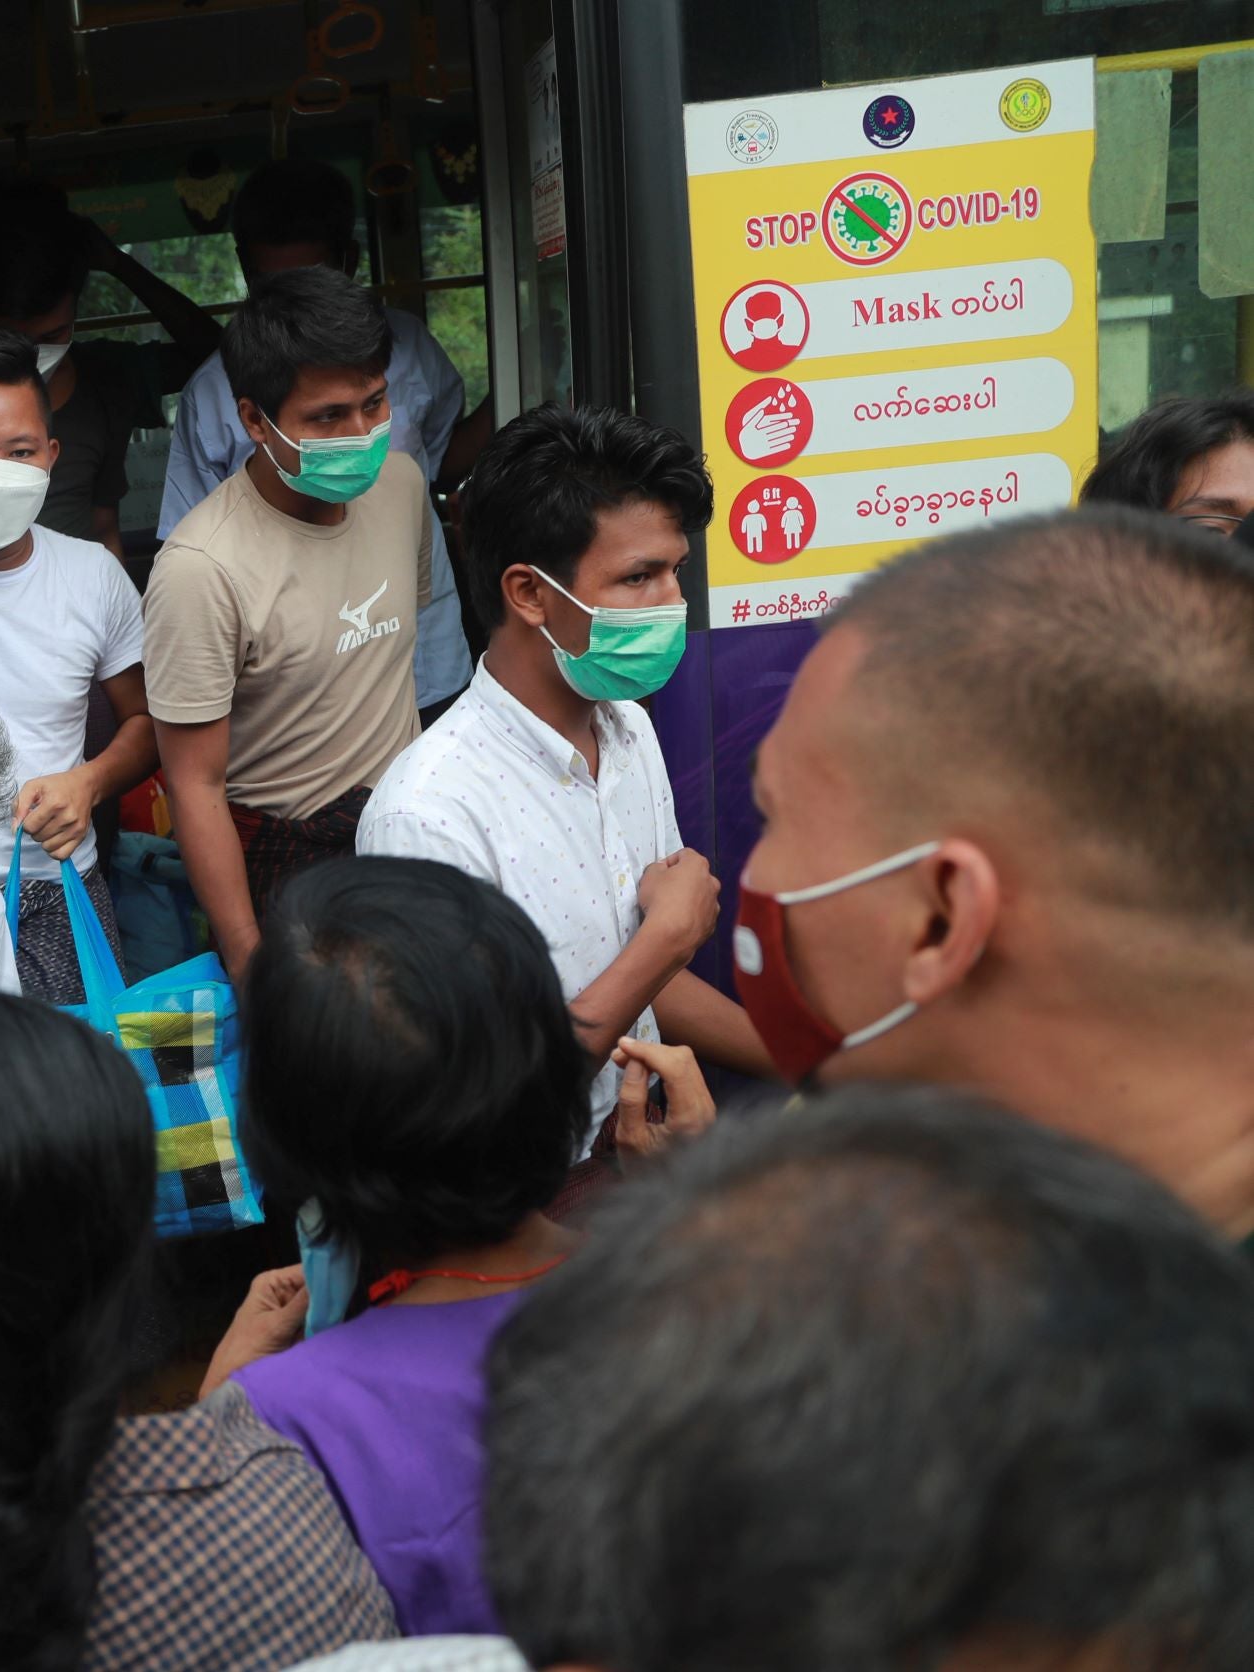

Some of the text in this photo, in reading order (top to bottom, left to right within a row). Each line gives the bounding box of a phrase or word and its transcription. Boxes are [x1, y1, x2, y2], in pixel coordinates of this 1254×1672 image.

[746, 187, 1038, 248] STOP COVID-19
[851, 277, 1024, 327] Mask တပ်ပါ
[853, 376, 996, 421] လက်ဆေးပါ
[762, 487, 771, 501] 6
[856, 471, 1018, 527] ခပ်ခွာခွာနေပါ
